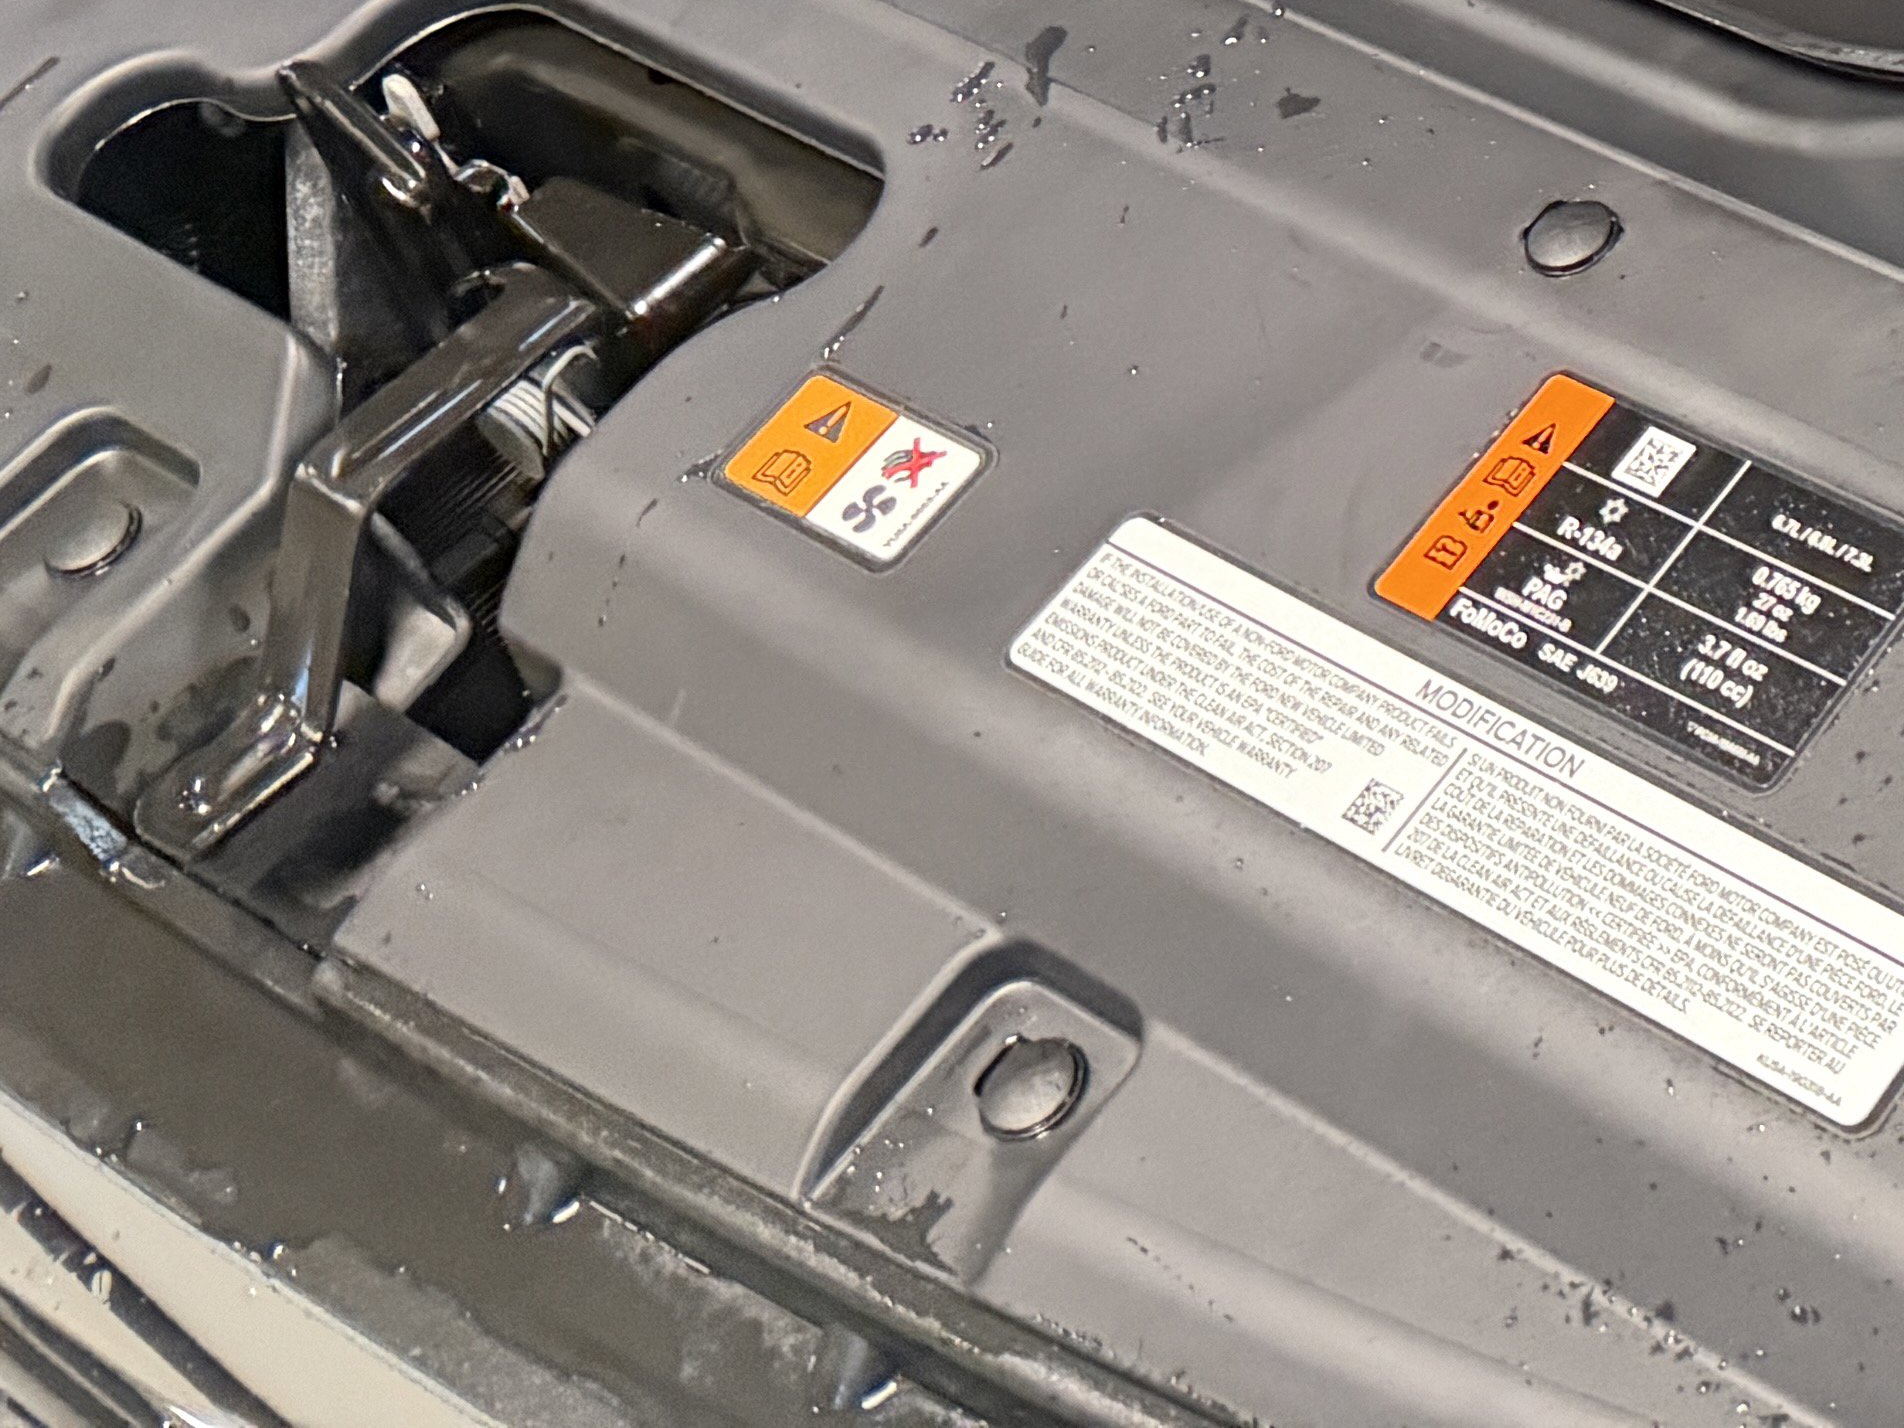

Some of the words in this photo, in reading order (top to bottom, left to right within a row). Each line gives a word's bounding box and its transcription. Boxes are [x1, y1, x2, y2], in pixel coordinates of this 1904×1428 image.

[1555, 514, 1623, 561] R-134a
[1520, 575, 1567, 610] PAG
[1751, 565, 1802, 600] 0.765
[1793, 585, 1821, 615] kg
[1448, 596, 1527, 649] FoMoCo
[1536, 642, 1578, 672] SAE
[1695, 633, 1732, 660] 3.7
[1740, 658, 1769, 681] oz
[1679, 657, 1724, 690] (110
[1718, 679, 1754, 709] cc)
[1414, 678, 1585, 778] MODIFICATION
